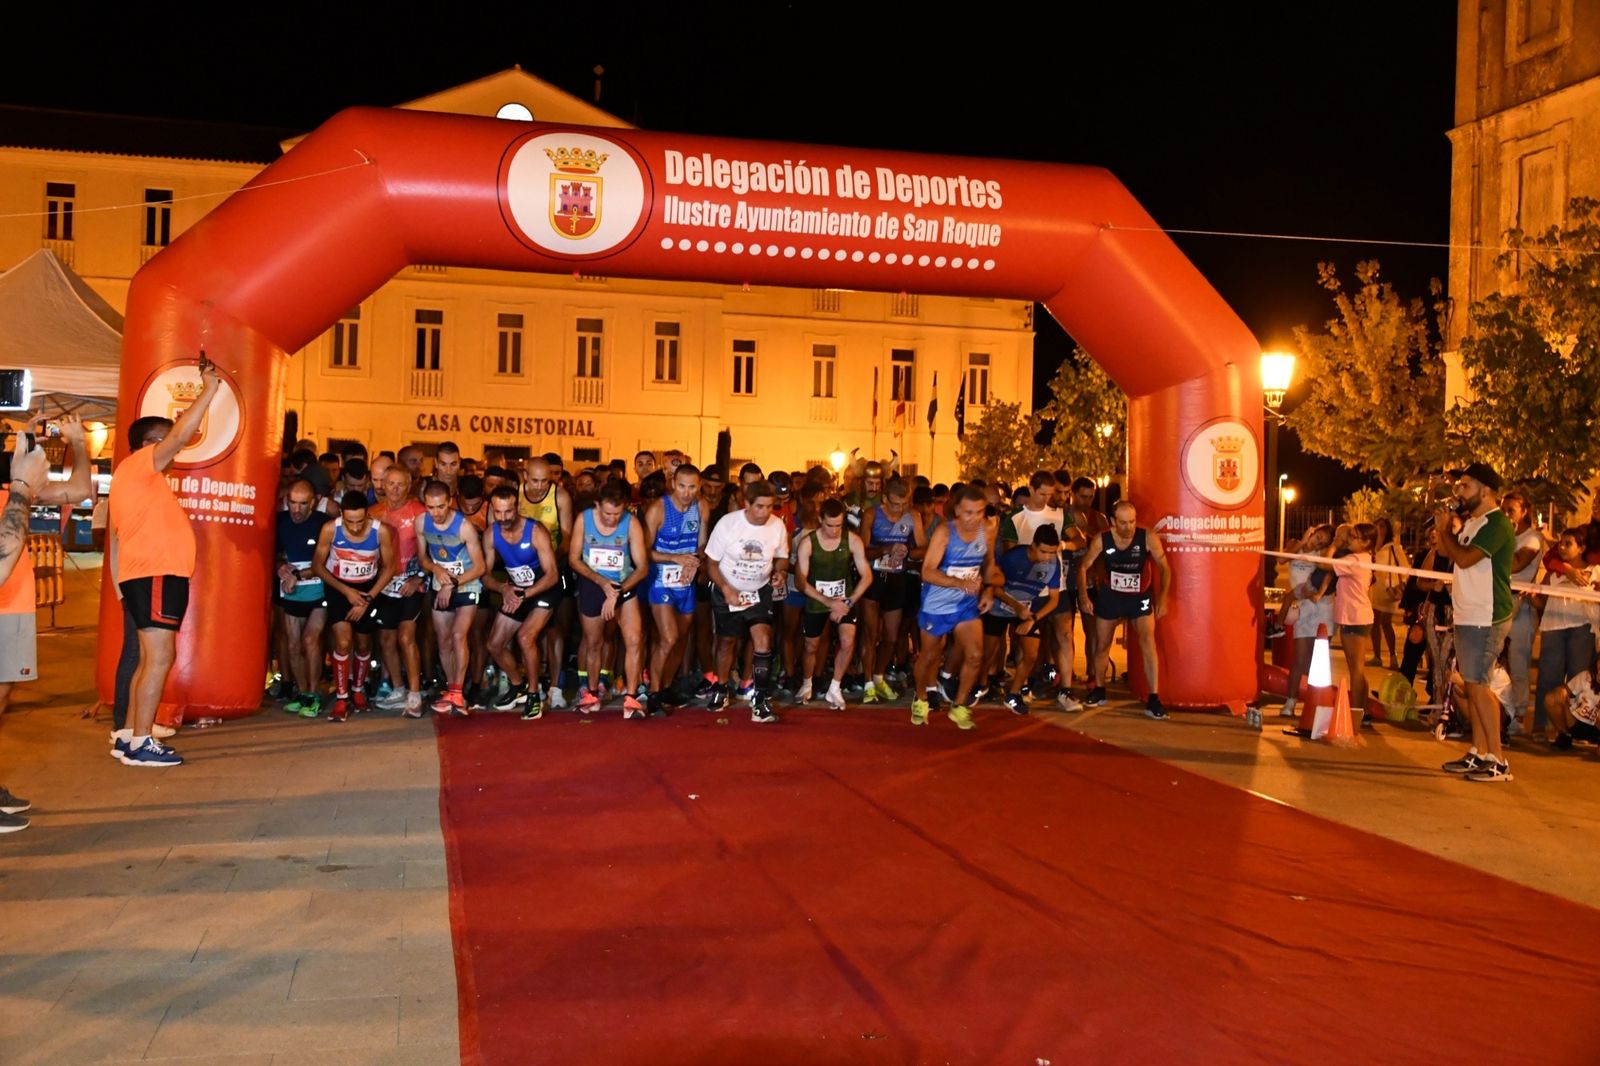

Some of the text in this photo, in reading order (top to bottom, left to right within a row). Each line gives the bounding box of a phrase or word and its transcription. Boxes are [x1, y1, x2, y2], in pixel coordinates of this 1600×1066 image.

[664, 150, 1003, 209] Delegación de Deportes
[664, 196, 1001, 248] Ilustre Ayuntamiento de San Roque
[416, 413, 595, 437] CASA CONSISTORIAL
[181, 476, 199, 493] de
[201, 477, 256, 500] Deportes
[199, 498, 211, 511] de
[212, 498, 230, 512] San
[230, 501, 255, 515] Roque
[1167, 514, 1227, 531] Delegación
[1228, 514, 1241, 530] de
[607, 556, 619, 565] 50
[829, 585, 844, 595] 123
[1123, 578, 1139, 587] 175
